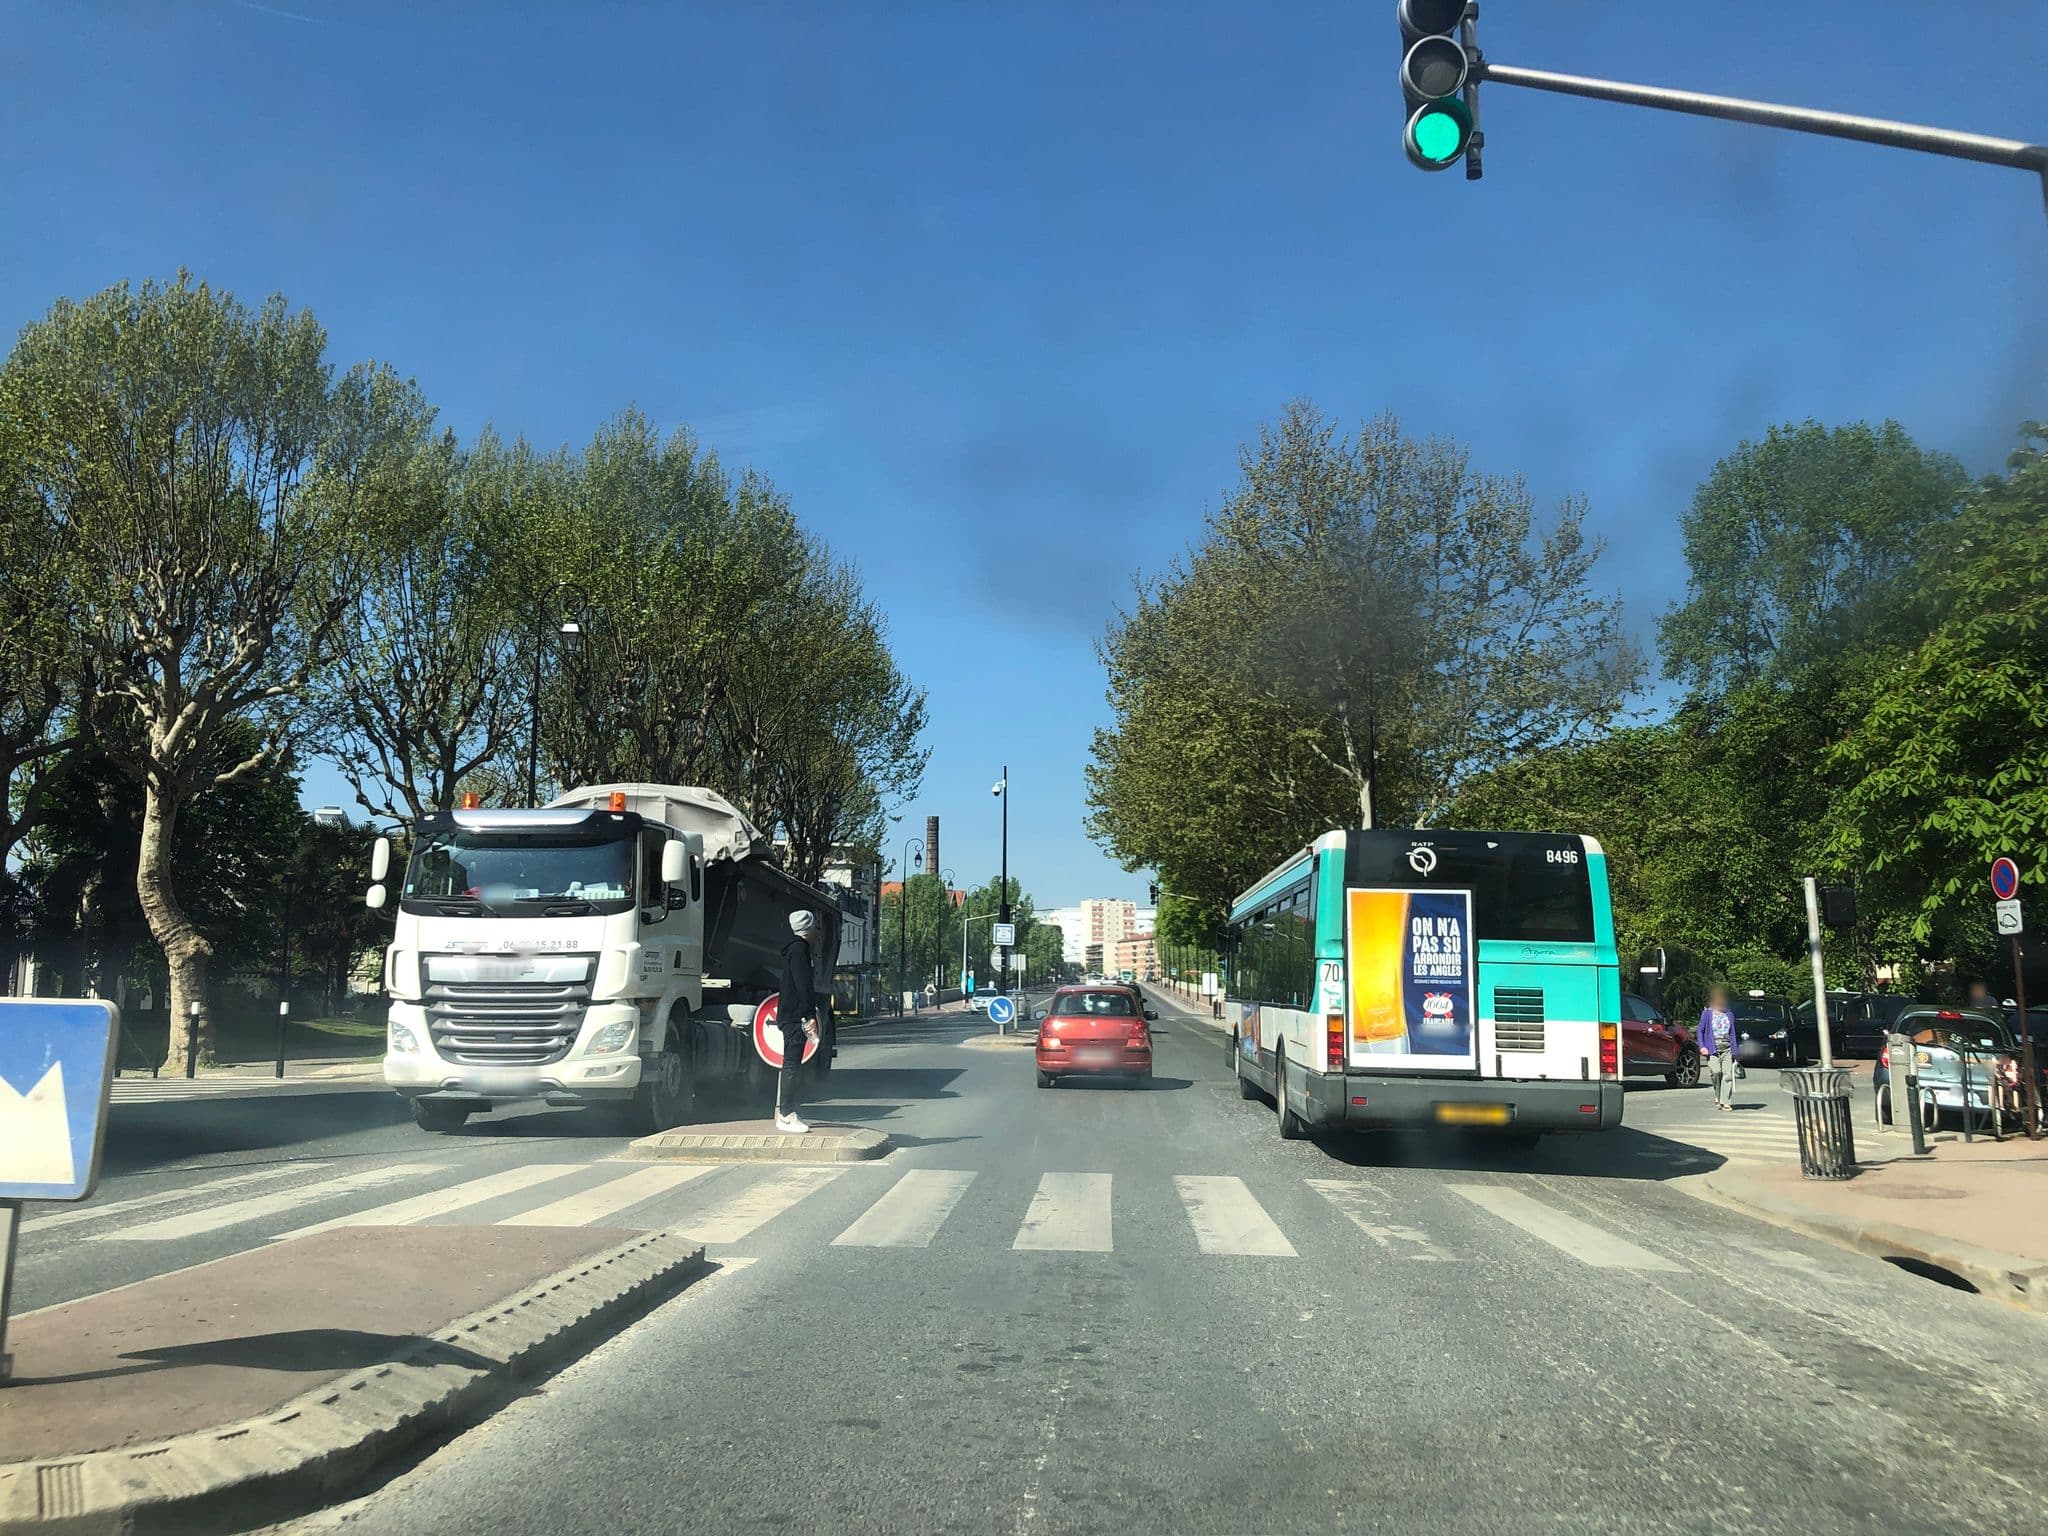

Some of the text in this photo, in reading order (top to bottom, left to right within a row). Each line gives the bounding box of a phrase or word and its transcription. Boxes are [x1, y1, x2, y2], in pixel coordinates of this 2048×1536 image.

[1546, 849, 1578, 864] 8496
[1412, 917, 1461, 936] ON N'A
[1412, 936, 1461, 953] PAS SU
[1413, 953, 1462, 966] ARRONDIR
[1323, 963, 1340, 982] 70
[1413, 965, 1462, 977] LES ANGLES
